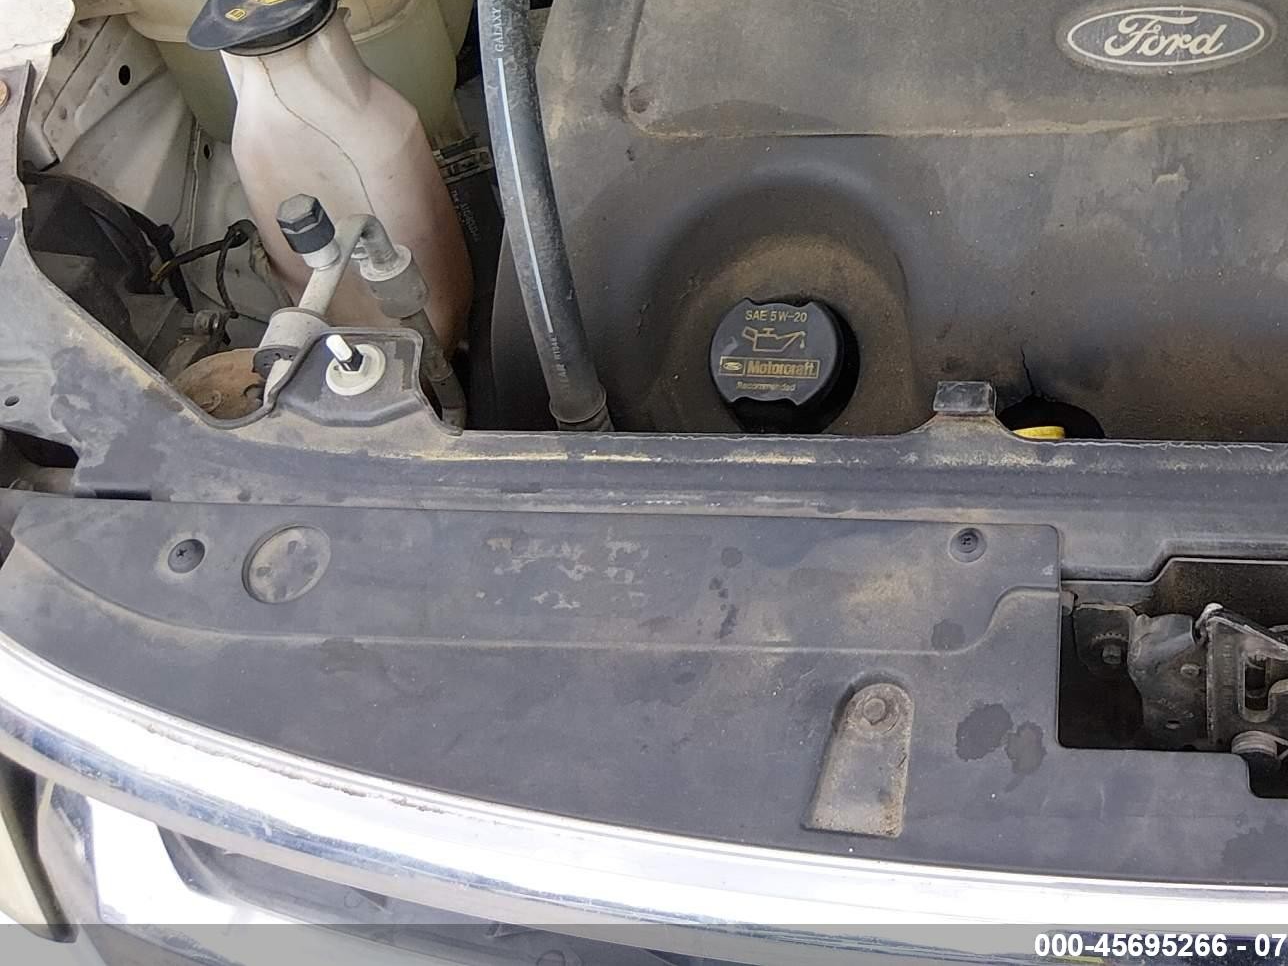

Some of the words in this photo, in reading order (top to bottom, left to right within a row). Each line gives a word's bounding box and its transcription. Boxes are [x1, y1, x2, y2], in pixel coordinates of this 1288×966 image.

[492, 7, 504, 52] GALAXY
[1103, 14, 1228, 57] Ford
[744, 310, 768, 322] SAE
